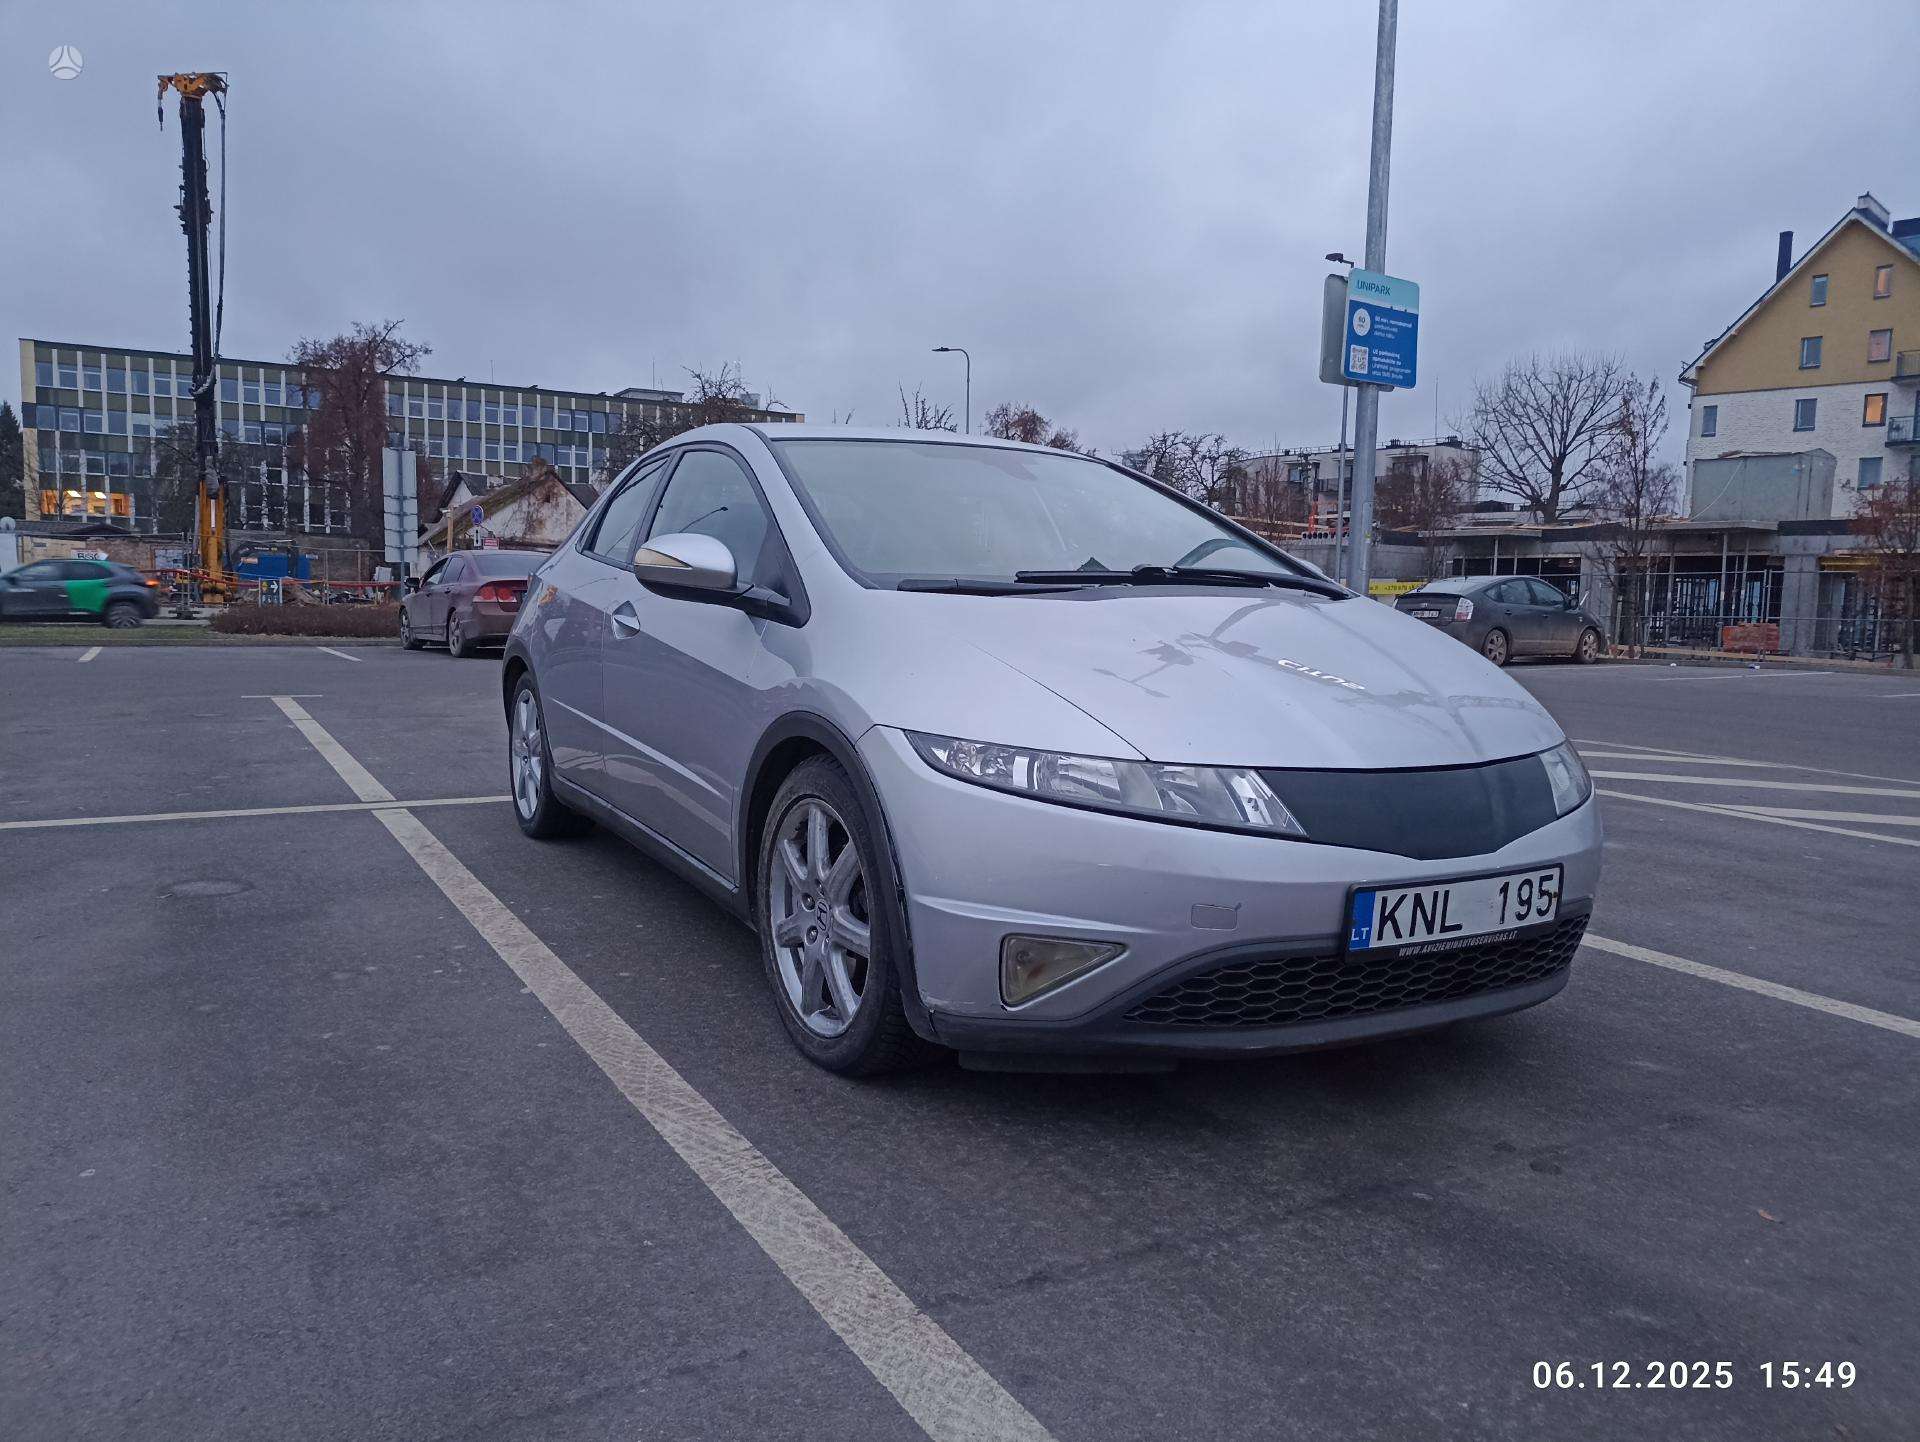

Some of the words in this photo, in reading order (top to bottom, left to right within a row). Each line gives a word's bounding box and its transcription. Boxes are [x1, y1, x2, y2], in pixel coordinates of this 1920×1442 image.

[1357, 280, 1391, 296] UNIPARK
[1377, 889, 1463, 941] KNL
[1499, 874, 1554, 925] 195
[1351, 927, 1370, 941] LT
